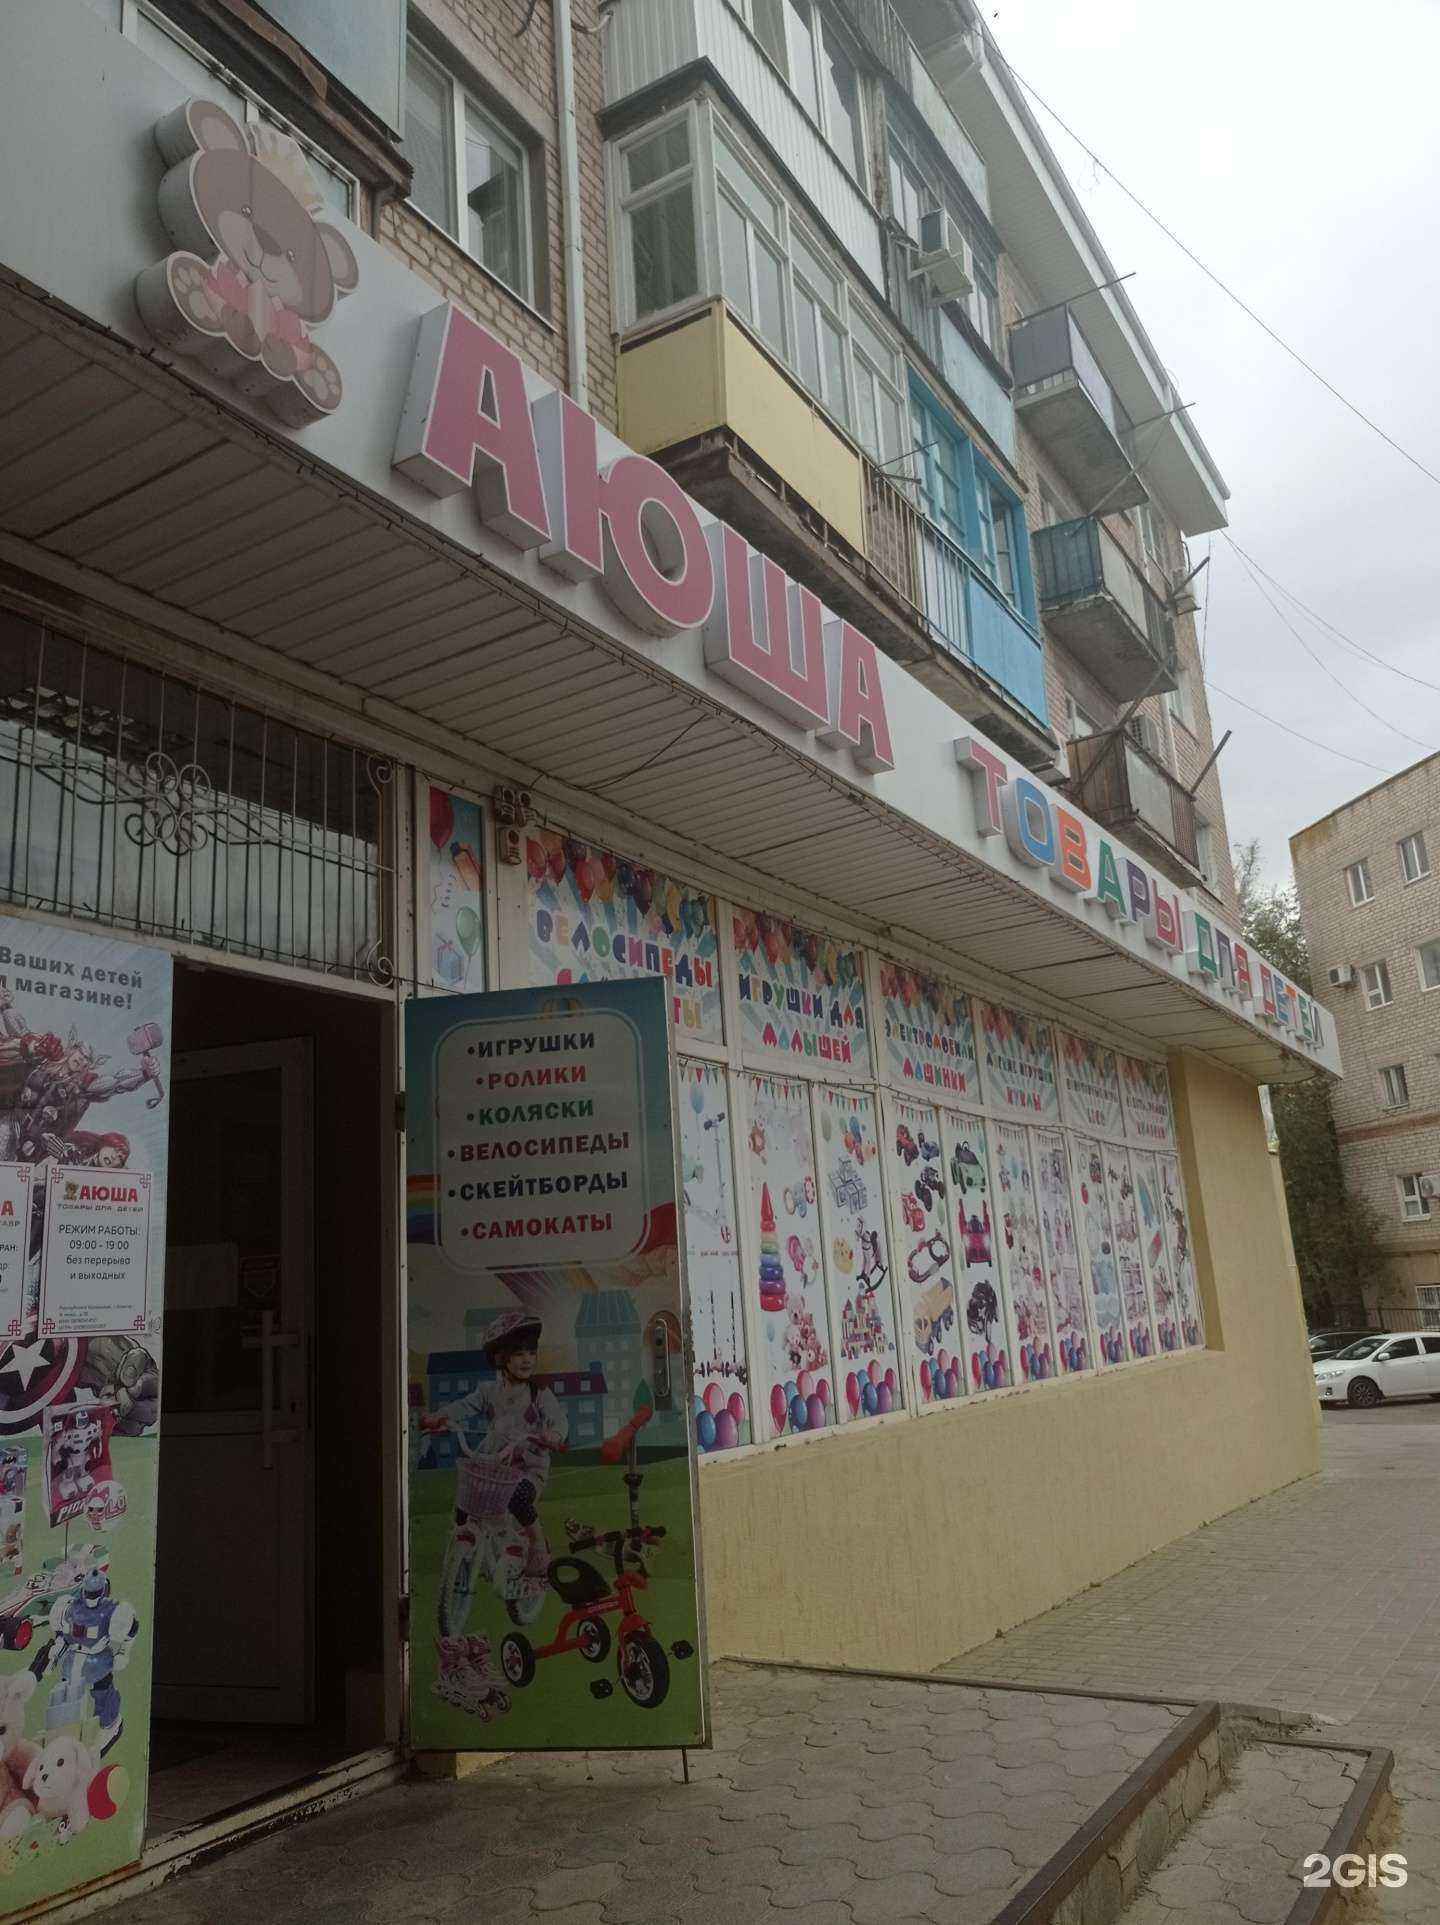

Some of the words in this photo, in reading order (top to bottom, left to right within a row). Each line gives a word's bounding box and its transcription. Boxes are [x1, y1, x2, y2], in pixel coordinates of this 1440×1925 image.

[408, 302, 896, 770] АЮША
[960, 738, 1184, 956] ТОВАРЫ
[1191, 912, 1253, 1001] ДЛЯ
[536, 909, 713, 989] ВЕЛОСИПЕДЫ
[0, 946, 75, 976] Ваших
[80, 966, 143, 989] детей
[15, 977, 133, 1010] магазине!
[738, 974, 824, 1019] ИГРУШКИ
[830, 1000, 865, 1030] ДЛЯ
[478, 1032, 595, 1059] ИГРУШКИ
[762, 1022, 853, 1064] МАЛЫШЕЙ
[488, 1065, 587, 1090] РОЛИКИ
[902, 1056, 967, 1093] МАШИНКИ
[479, 1099, 594, 1126] КОЛЯСКИ
[460, 1131, 630, 1162] ВЕЛОСИПЕДЫ
[80, 1183, 139, 1203] АЮША
[460, 1171, 628, 1202] СКЕЙТБОРДЫ
[58, 1224, 96, 1234] РЕЖИМ
[472, 1213, 613, 1240] САМОКАТЫ
[66, 1254, 82, 1265] без
[84, 1256, 131, 1266] перерыва
[69, 1240, 97, 1250] 09:00
